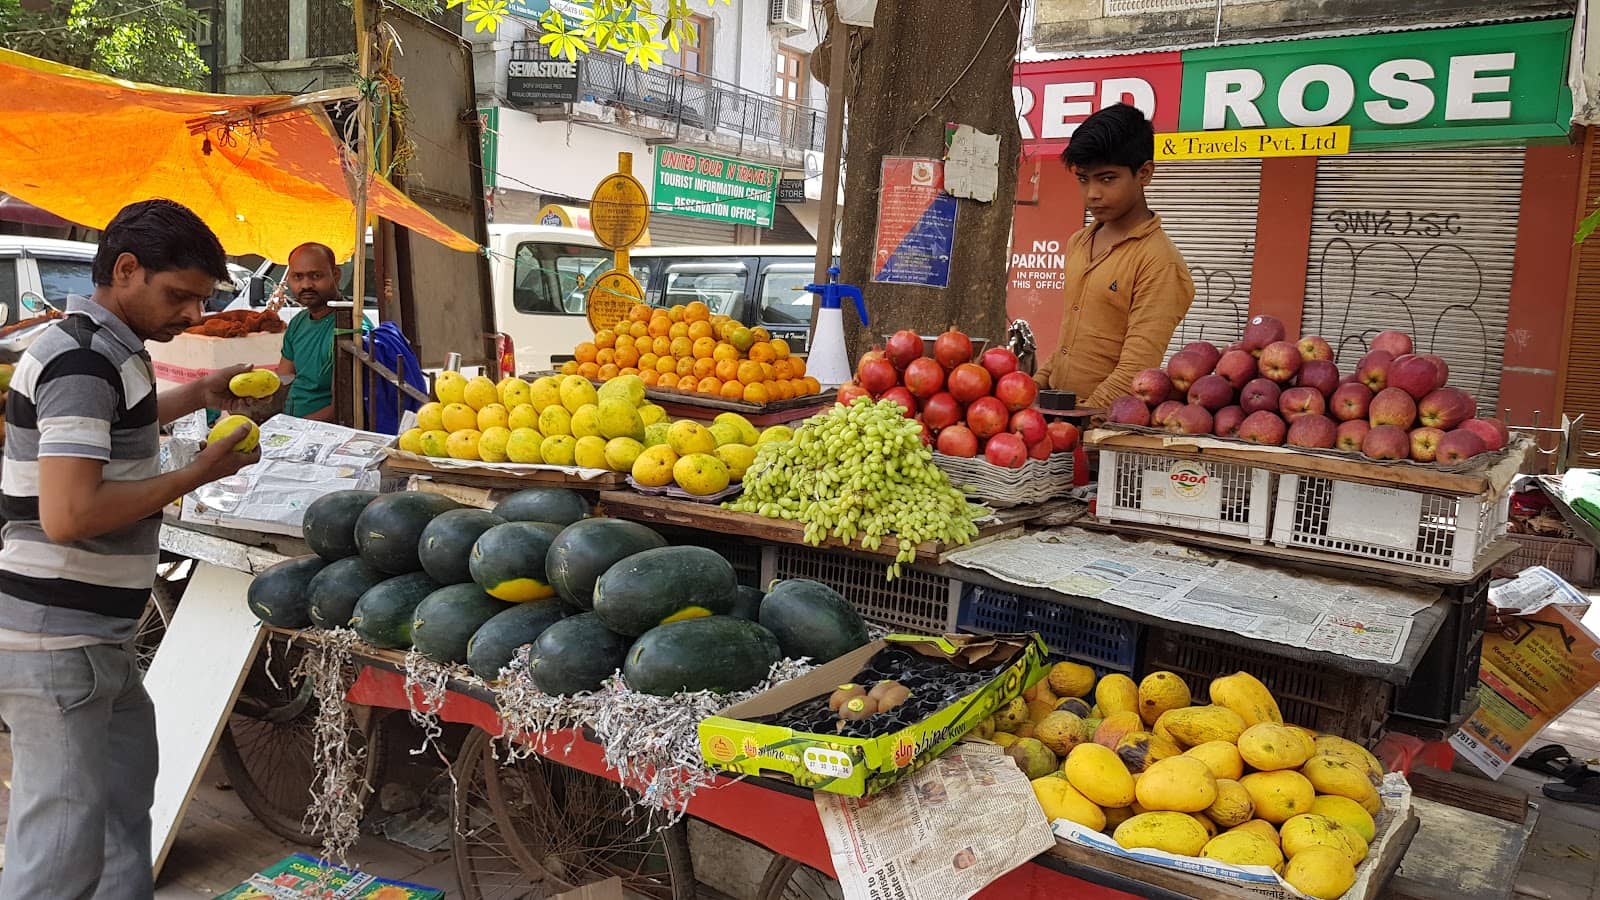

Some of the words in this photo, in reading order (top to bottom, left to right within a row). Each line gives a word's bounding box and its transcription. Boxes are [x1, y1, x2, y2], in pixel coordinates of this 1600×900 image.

[1012, 78, 1156, 139] RED
[1202, 52, 1516, 130] ROSE
[1162, 138, 1177, 155] &
[1183, 135, 1247, 154] Travels
[1259, 134, 1295, 152] Pvt.
[1300, 132, 1336, 150] Ltd
[660, 150, 696, 172] UNITED
[698, 158, 724, 178] TOUR
[727, 163, 736, 179] N
[660, 171, 694, 189] TOURIST
[694, 177, 744, 198] INFORMATION
[780, 189, 803, 198] STORE
[674, 197, 730, 217] RESERVATION
[731, 206, 757, 221] OFFICE
[1032, 240, 1060, 252] NO
[1011, 254, 1065, 268] PARKIN
[1028, 272, 1056, 280] FRONT
[1012, 280, 1031, 288] THIS
[1036, 281, 1065, 289] OFFIC
[885, 861, 896, 877] list
[868, 876, 876, 888] to
